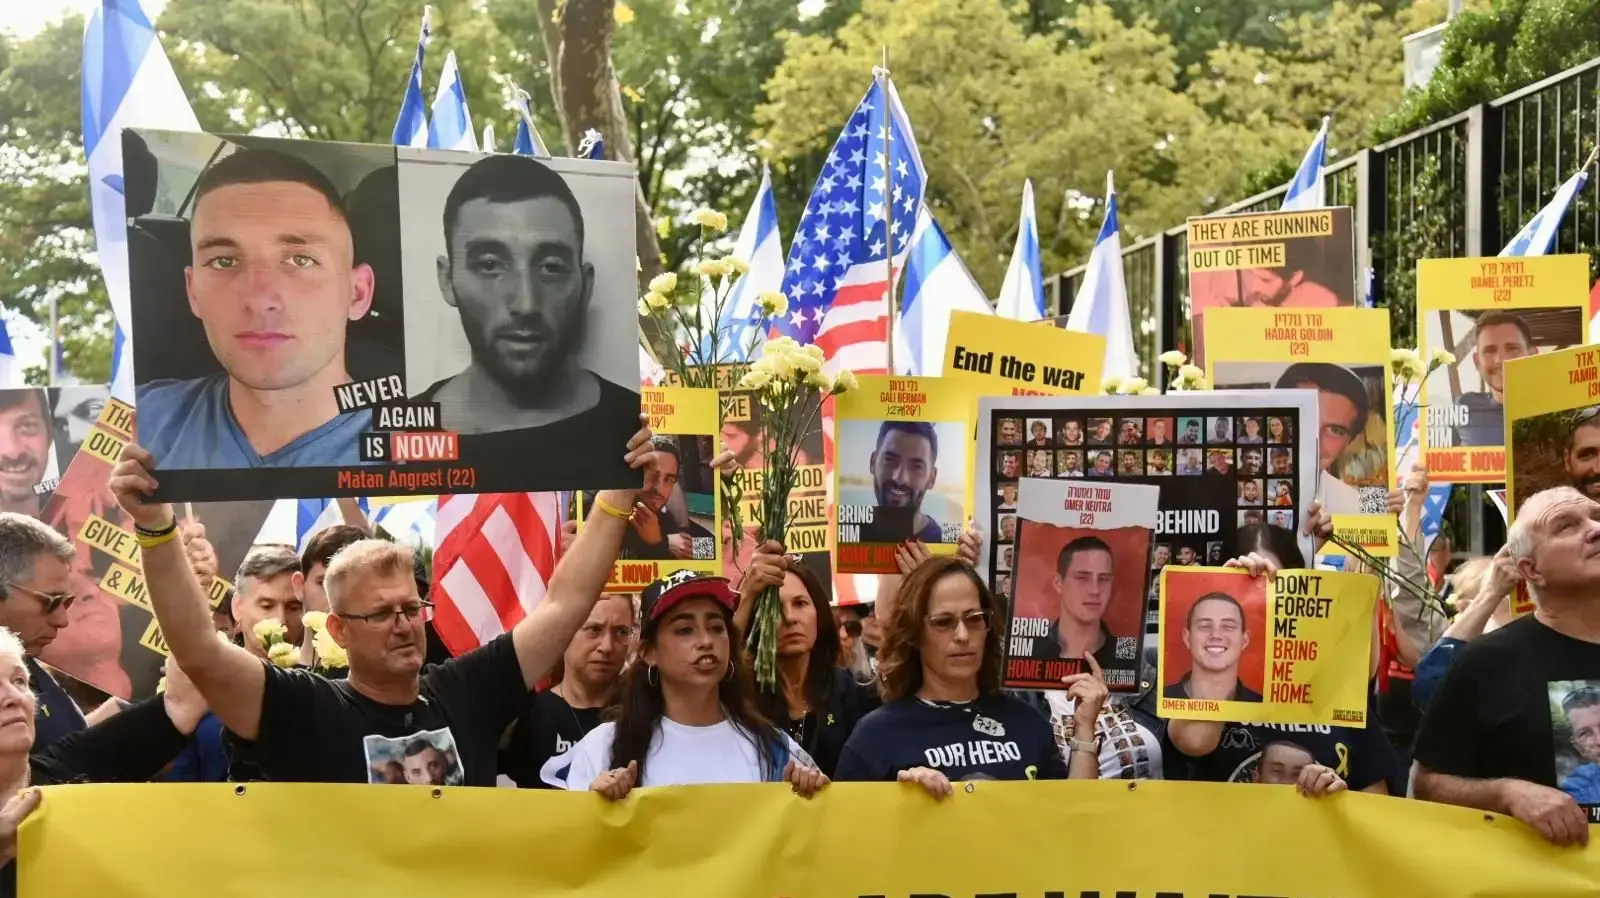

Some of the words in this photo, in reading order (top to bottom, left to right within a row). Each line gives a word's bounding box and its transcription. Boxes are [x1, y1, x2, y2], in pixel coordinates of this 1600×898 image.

[1192, 224, 1227, 242] THEY
[1232, 220, 1260, 238] ARE
[1264, 215, 1330, 236] RUNNING
[1193, 251, 1220, 269] OUT
[1226, 249, 1243, 266] OF
[1248, 246, 1282, 264] TIME
[1471, 276, 1500, 288] DANIEL
[1503, 275, 1535, 287] PERETZ
[1264, 328, 1297, 341] HADAR
[1300, 328, 1333, 341] GOLDIN
[1290, 341, 1309, 356] (23)
[953, 345, 994, 375] End
[1000, 355, 1036, 382] the
[1043, 366, 1085, 391] war
[1568, 366, 1598, 384] TAMIR
[338, 374, 405, 410] NEVER
[880, 392, 897, 403] GALI
[898, 392, 927, 404] BERMAN
[379, 406, 435, 428] AGAIN
[651, 404, 675, 416] COHEN
[1428, 404, 1469, 426] BRING
[366, 437, 384, 458] IS
[396, 435, 454, 459] NOW!
[1428, 426, 1453, 449] HIM
[1425, 452, 1467, 472] HOME
[338, 472, 384, 489] Matan
[388, 469, 443, 491] Angrest
[447, 468, 476, 489] (22)
[837, 505, 874, 524] BRING
[1064, 499, 1084, 511] OMER
[1085, 500, 1112, 513] NEUTRA
[1079, 512, 1094, 525] (22)
[1155, 509, 1220, 534] BEHIND
[84, 520, 129, 554] GIVE
[791, 529, 826, 550] NOW
[837, 524, 860, 543] HIM
[1275, 575, 1322, 596] DON'T
[1274, 596, 1333, 618] FORGET
[1011, 617, 1050, 637] BRING
[1273, 618, 1298, 638] ME
[1009, 638, 1034, 657] HIM
[1273, 639, 1318, 661] BRING
[1007, 660, 1042, 679] HOME
[1272, 661, 1295, 681] ME
[1270, 682, 1314, 704] HOME.
[1162, 699, 1186, 711] OMER
[1187, 700, 1220, 712] NEUTRA
[924, 742, 967, 767] OUR
[968, 740, 1021, 765] HERO
